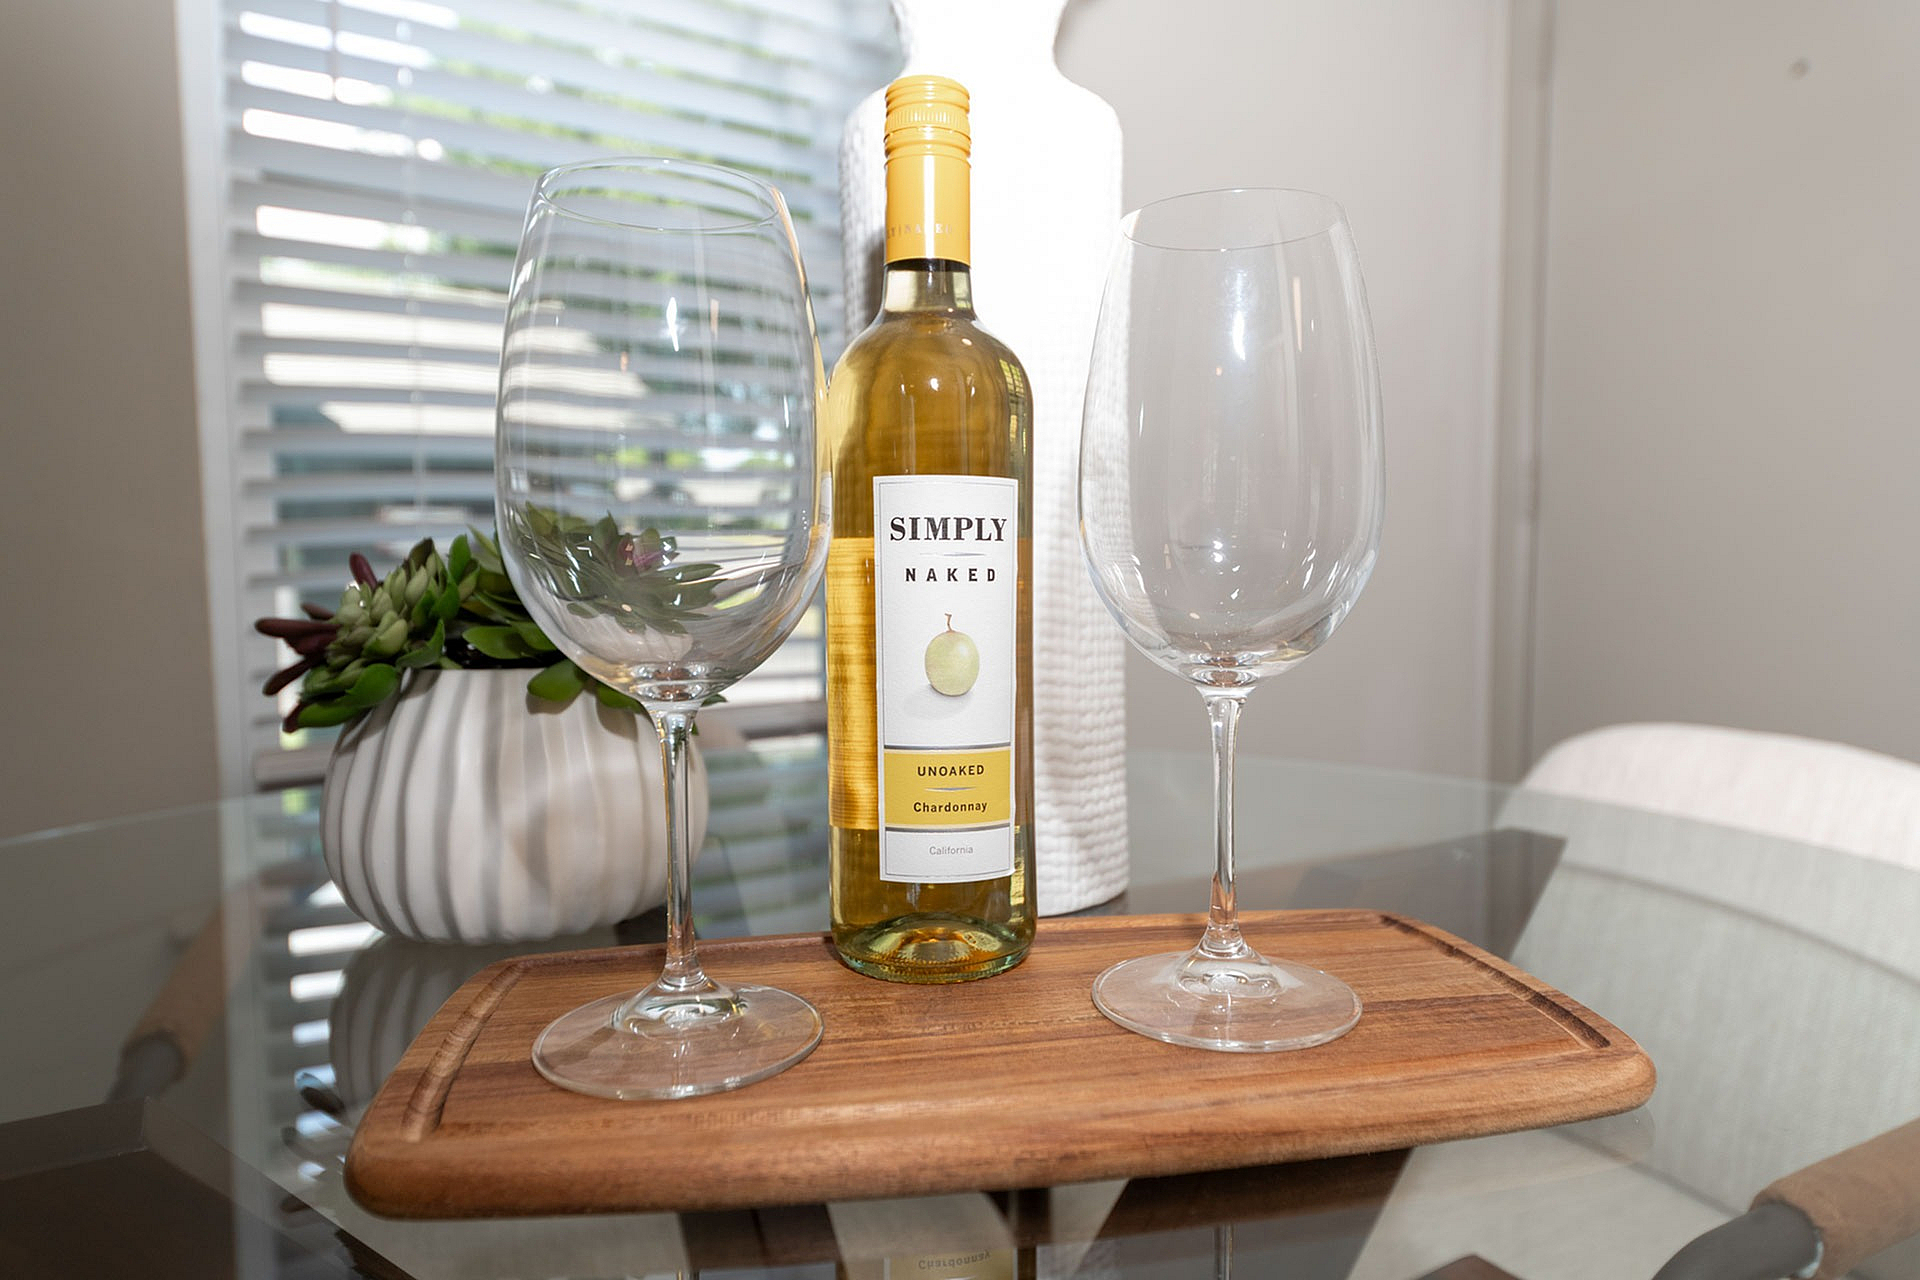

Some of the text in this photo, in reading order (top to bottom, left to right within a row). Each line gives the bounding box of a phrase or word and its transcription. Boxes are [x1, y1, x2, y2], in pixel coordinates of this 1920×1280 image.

[890, 516, 1008, 542] SIMPLY
[905, 567, 996, 582] NAKED
[917, 764, 985, 777] UNOAKED
[913, 801, 988, 813] Chardonnay
[929, 845, 974, 856] California
